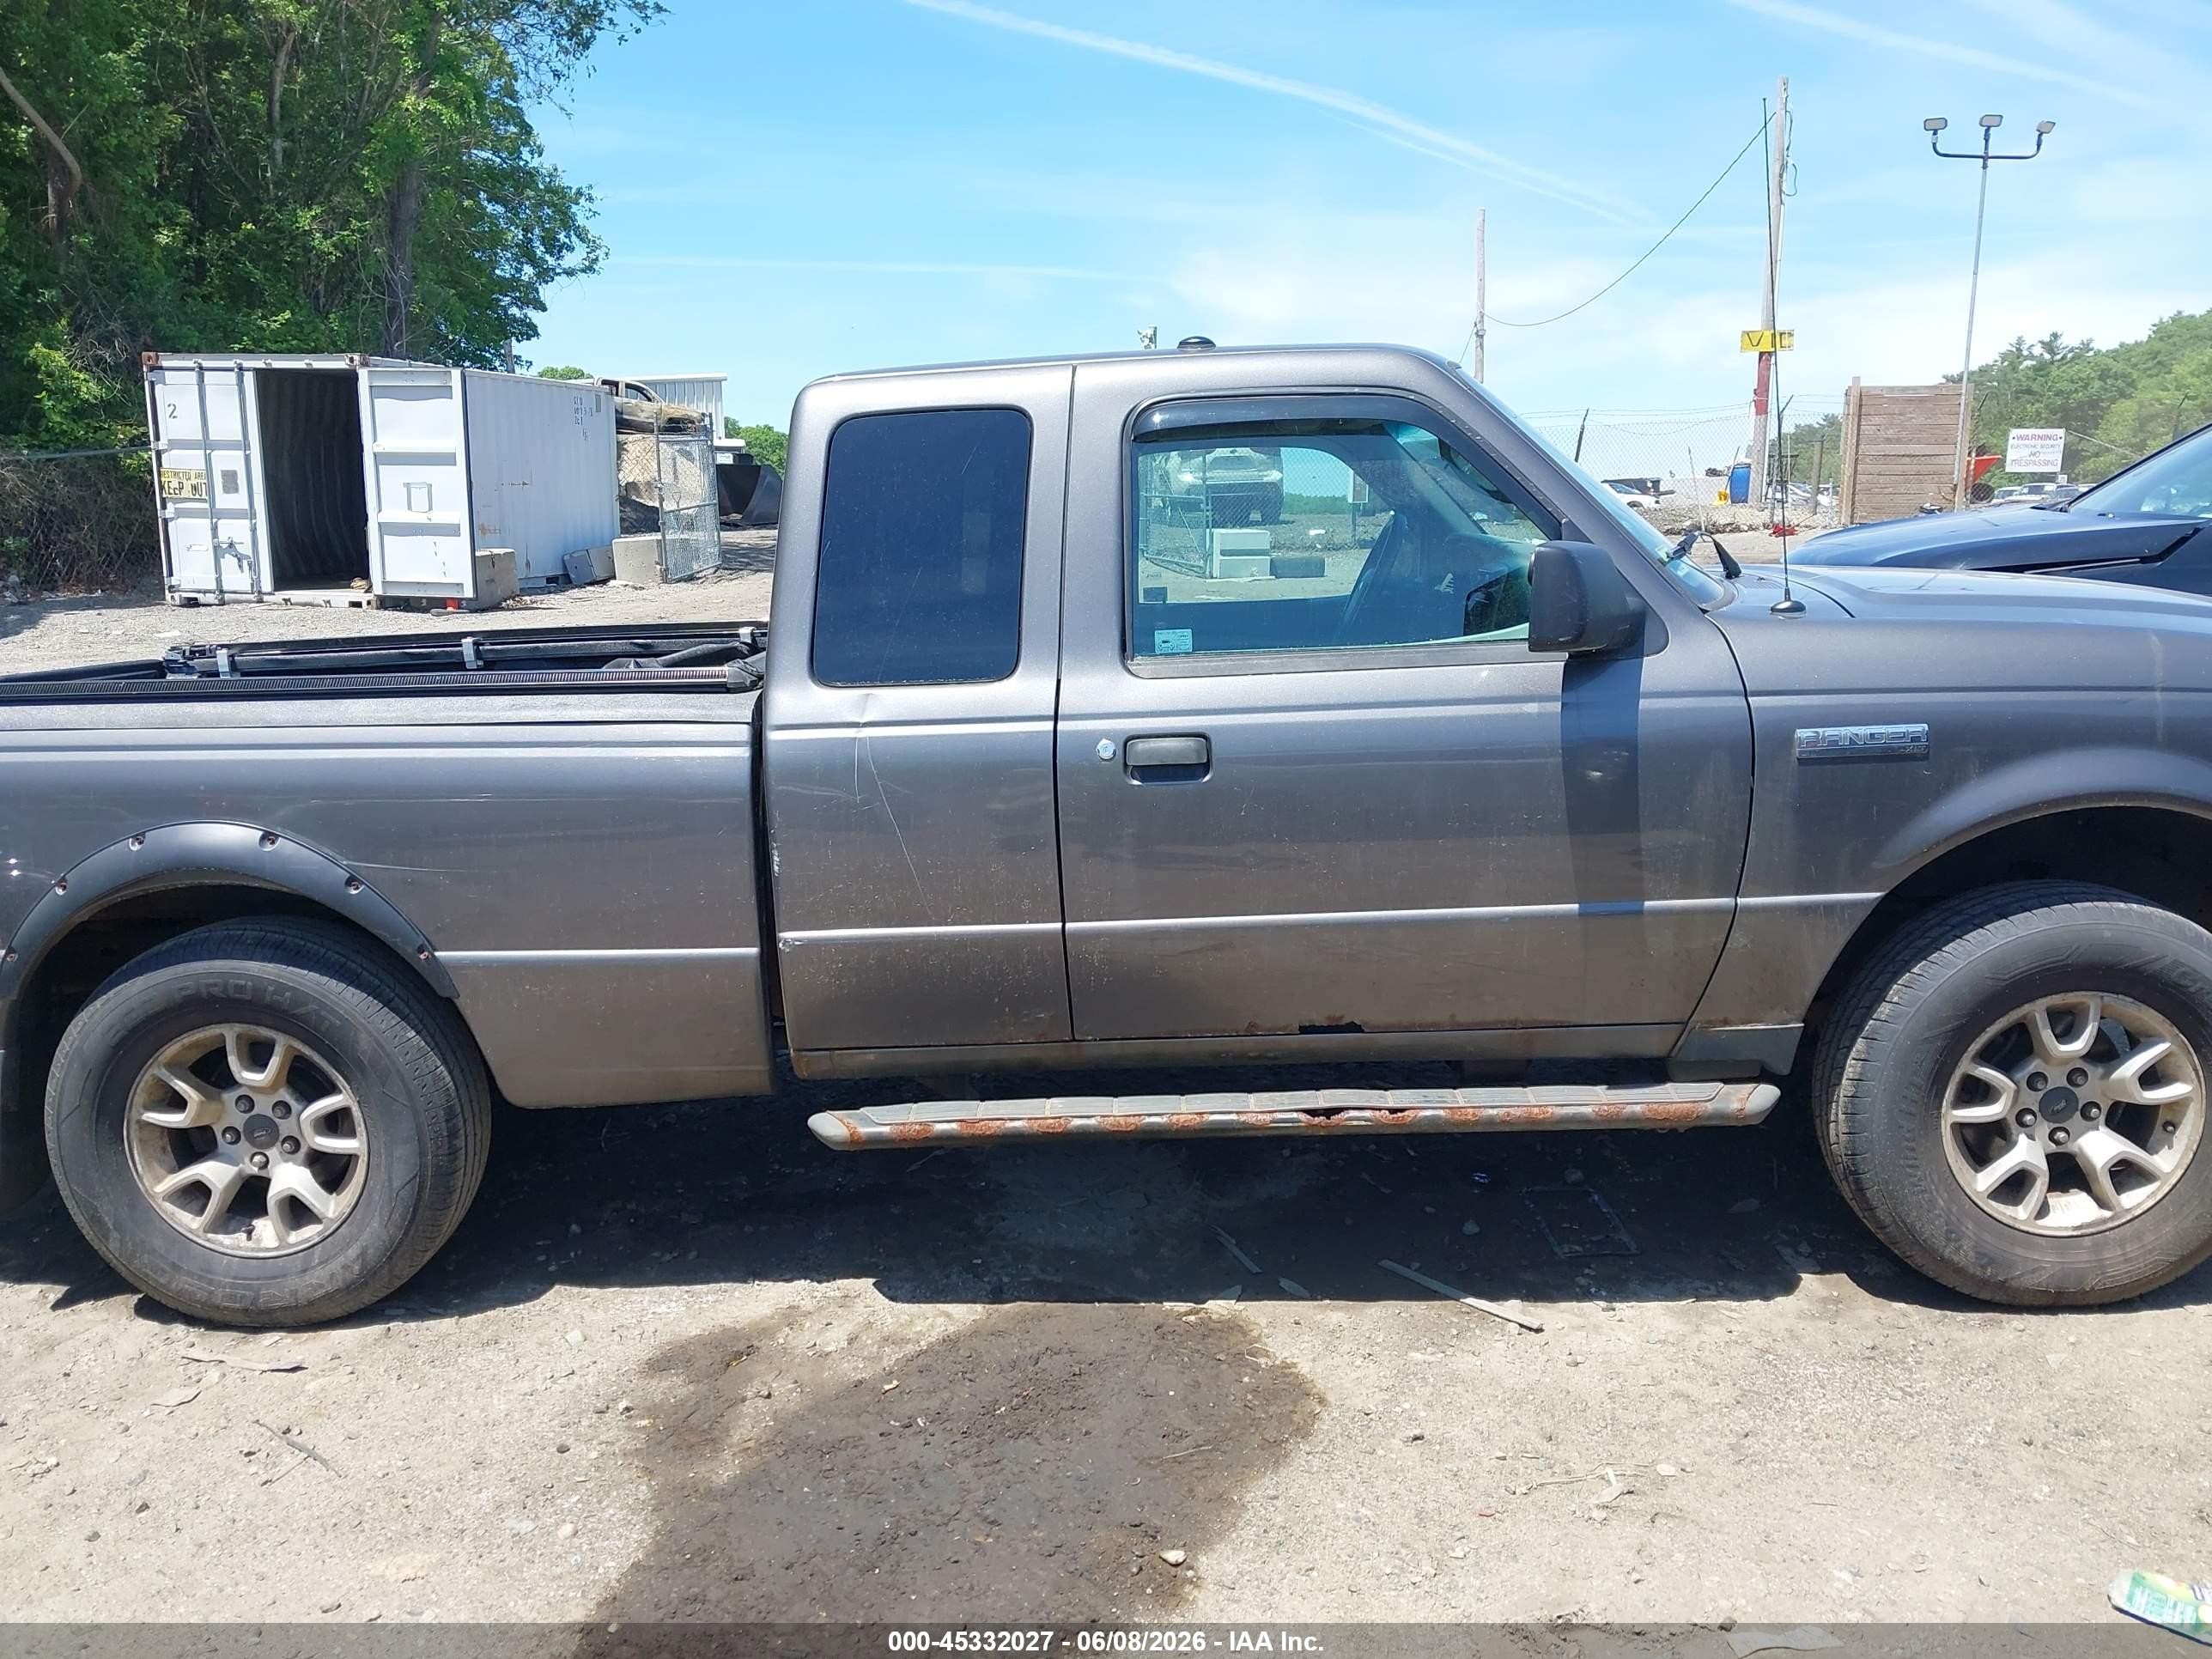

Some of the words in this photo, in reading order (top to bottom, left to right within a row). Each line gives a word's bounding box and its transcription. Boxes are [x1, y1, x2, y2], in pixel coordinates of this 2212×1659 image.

[167, 403, 179, 420] 2
[2015, 433, 2058, 441] WARNING
[2010, 459, 2059, 467] TRESPASSING
[1800, 726, 1928, 747] RANGER
[172, 978, 253, 1004] PRO
